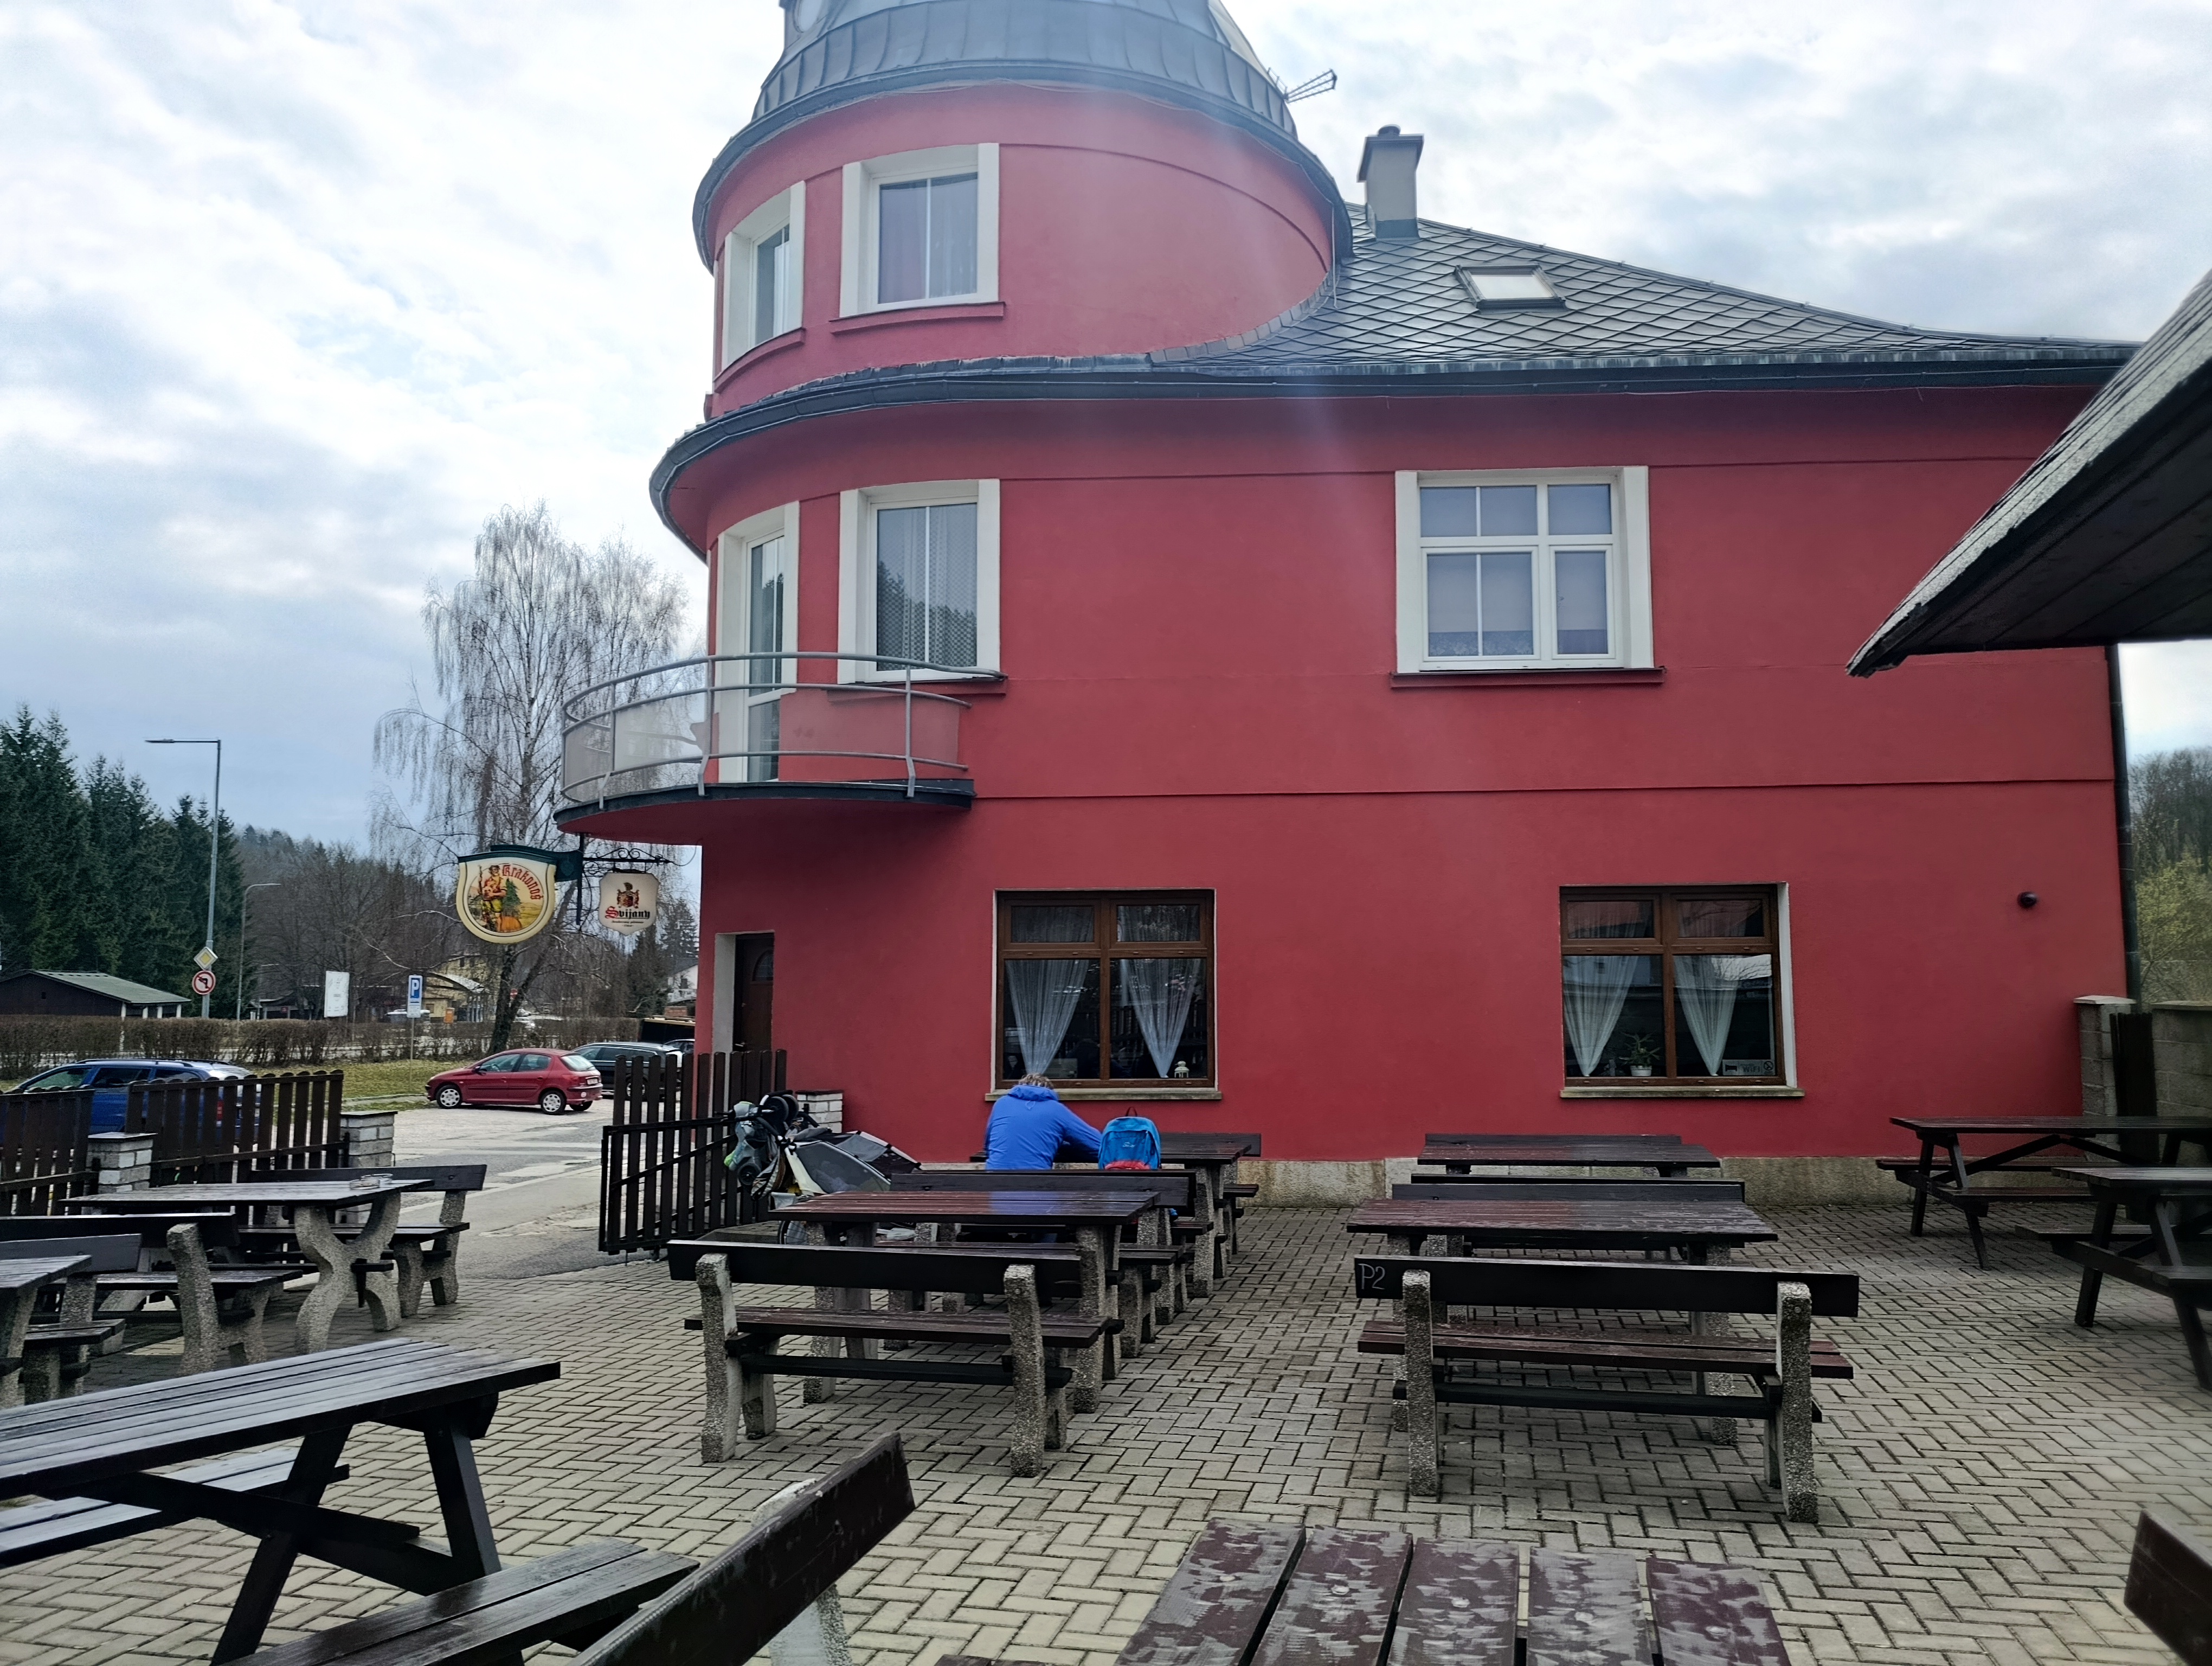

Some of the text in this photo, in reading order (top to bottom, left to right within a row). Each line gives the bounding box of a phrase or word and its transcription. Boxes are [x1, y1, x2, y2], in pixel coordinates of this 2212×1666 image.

[605, 906, 650, 919] Svijany
[411, 979, 420, 996] P
[1358, 1263, 1386, 1290] P2
